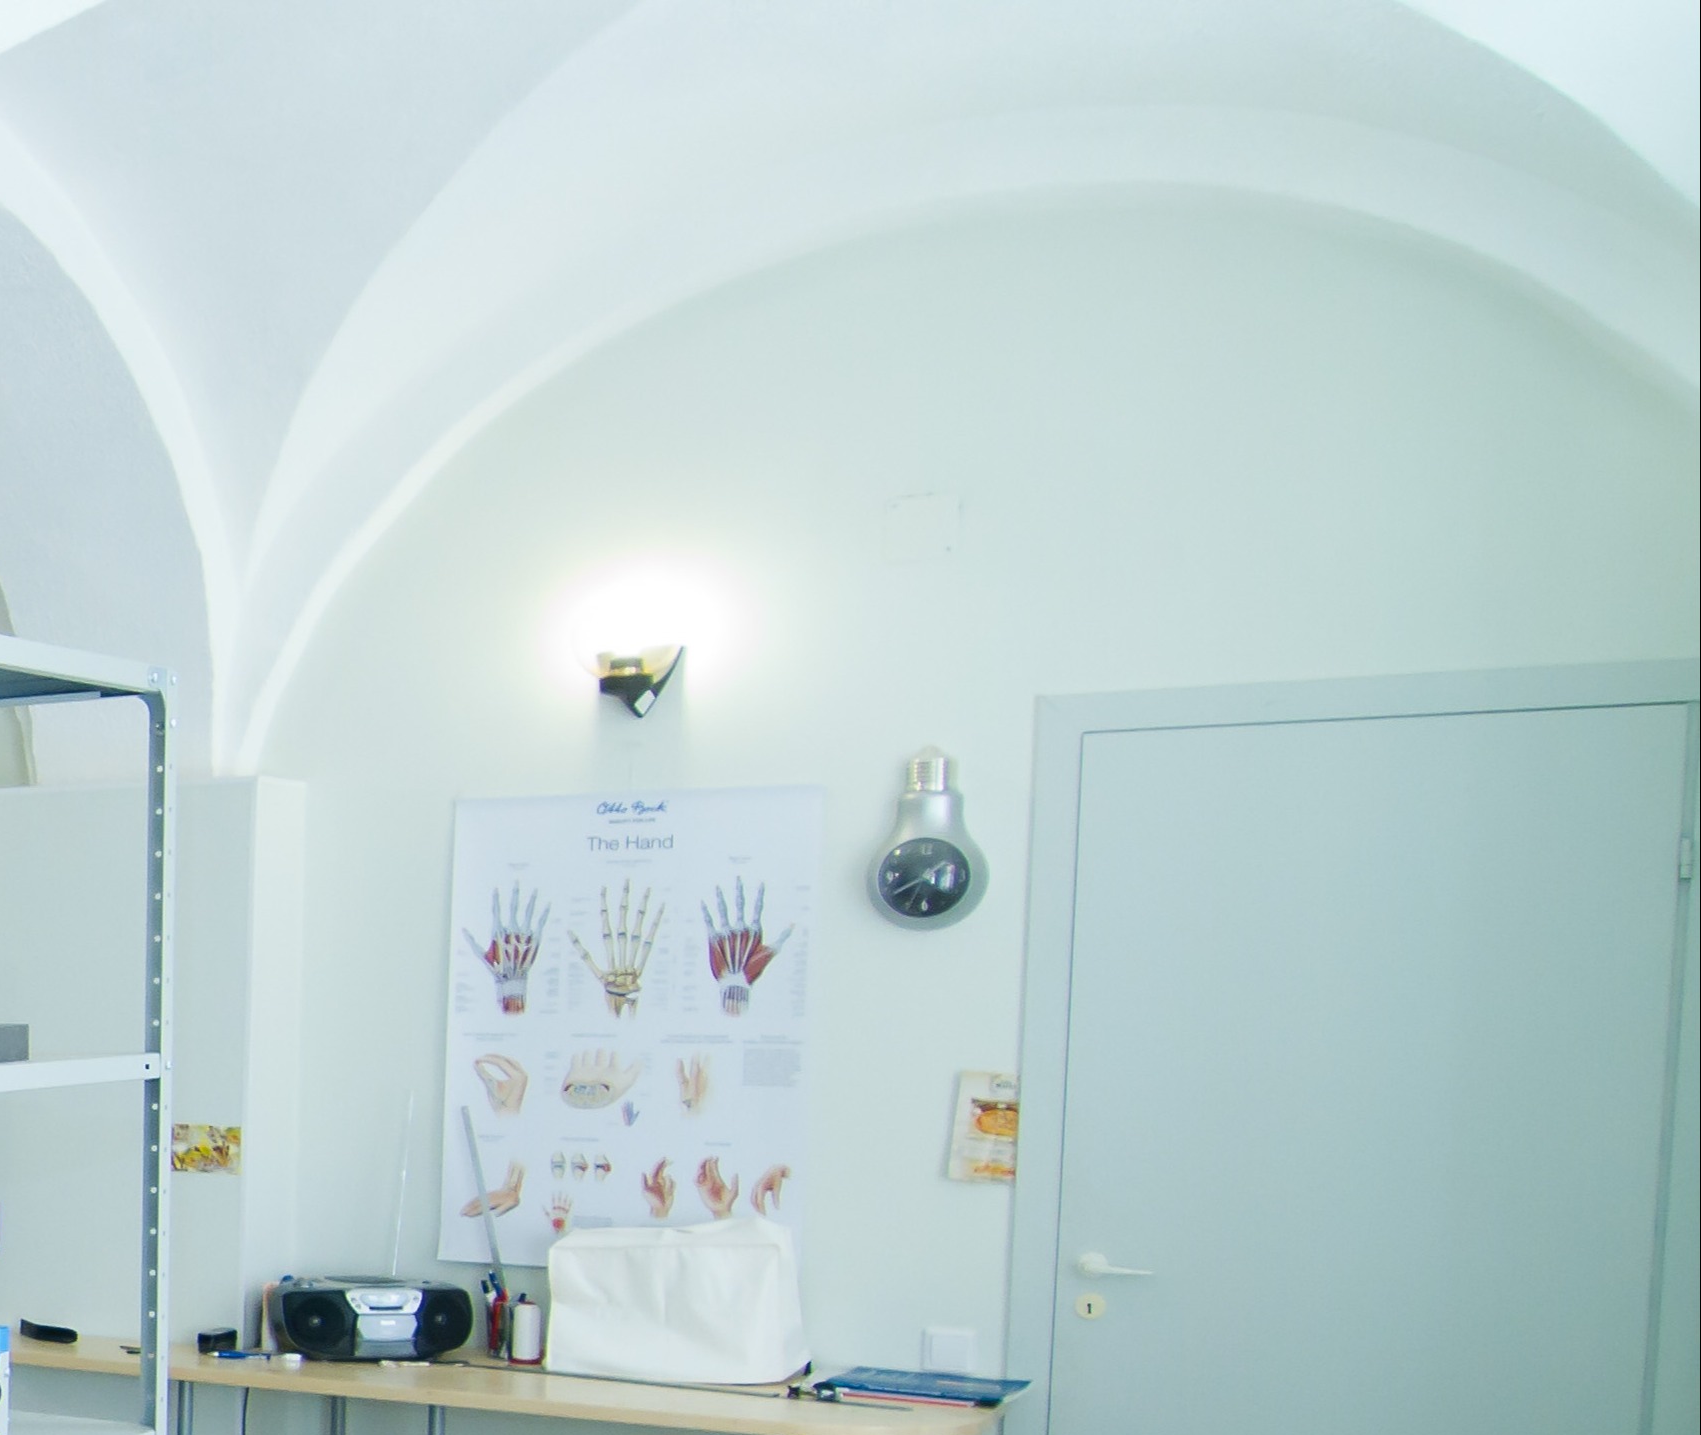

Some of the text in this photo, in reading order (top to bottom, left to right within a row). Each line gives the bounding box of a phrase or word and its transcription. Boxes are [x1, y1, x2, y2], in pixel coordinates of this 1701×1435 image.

[587, 834, 674, 851] The Hand
[1086, 1302, 1092, 1314] 1
